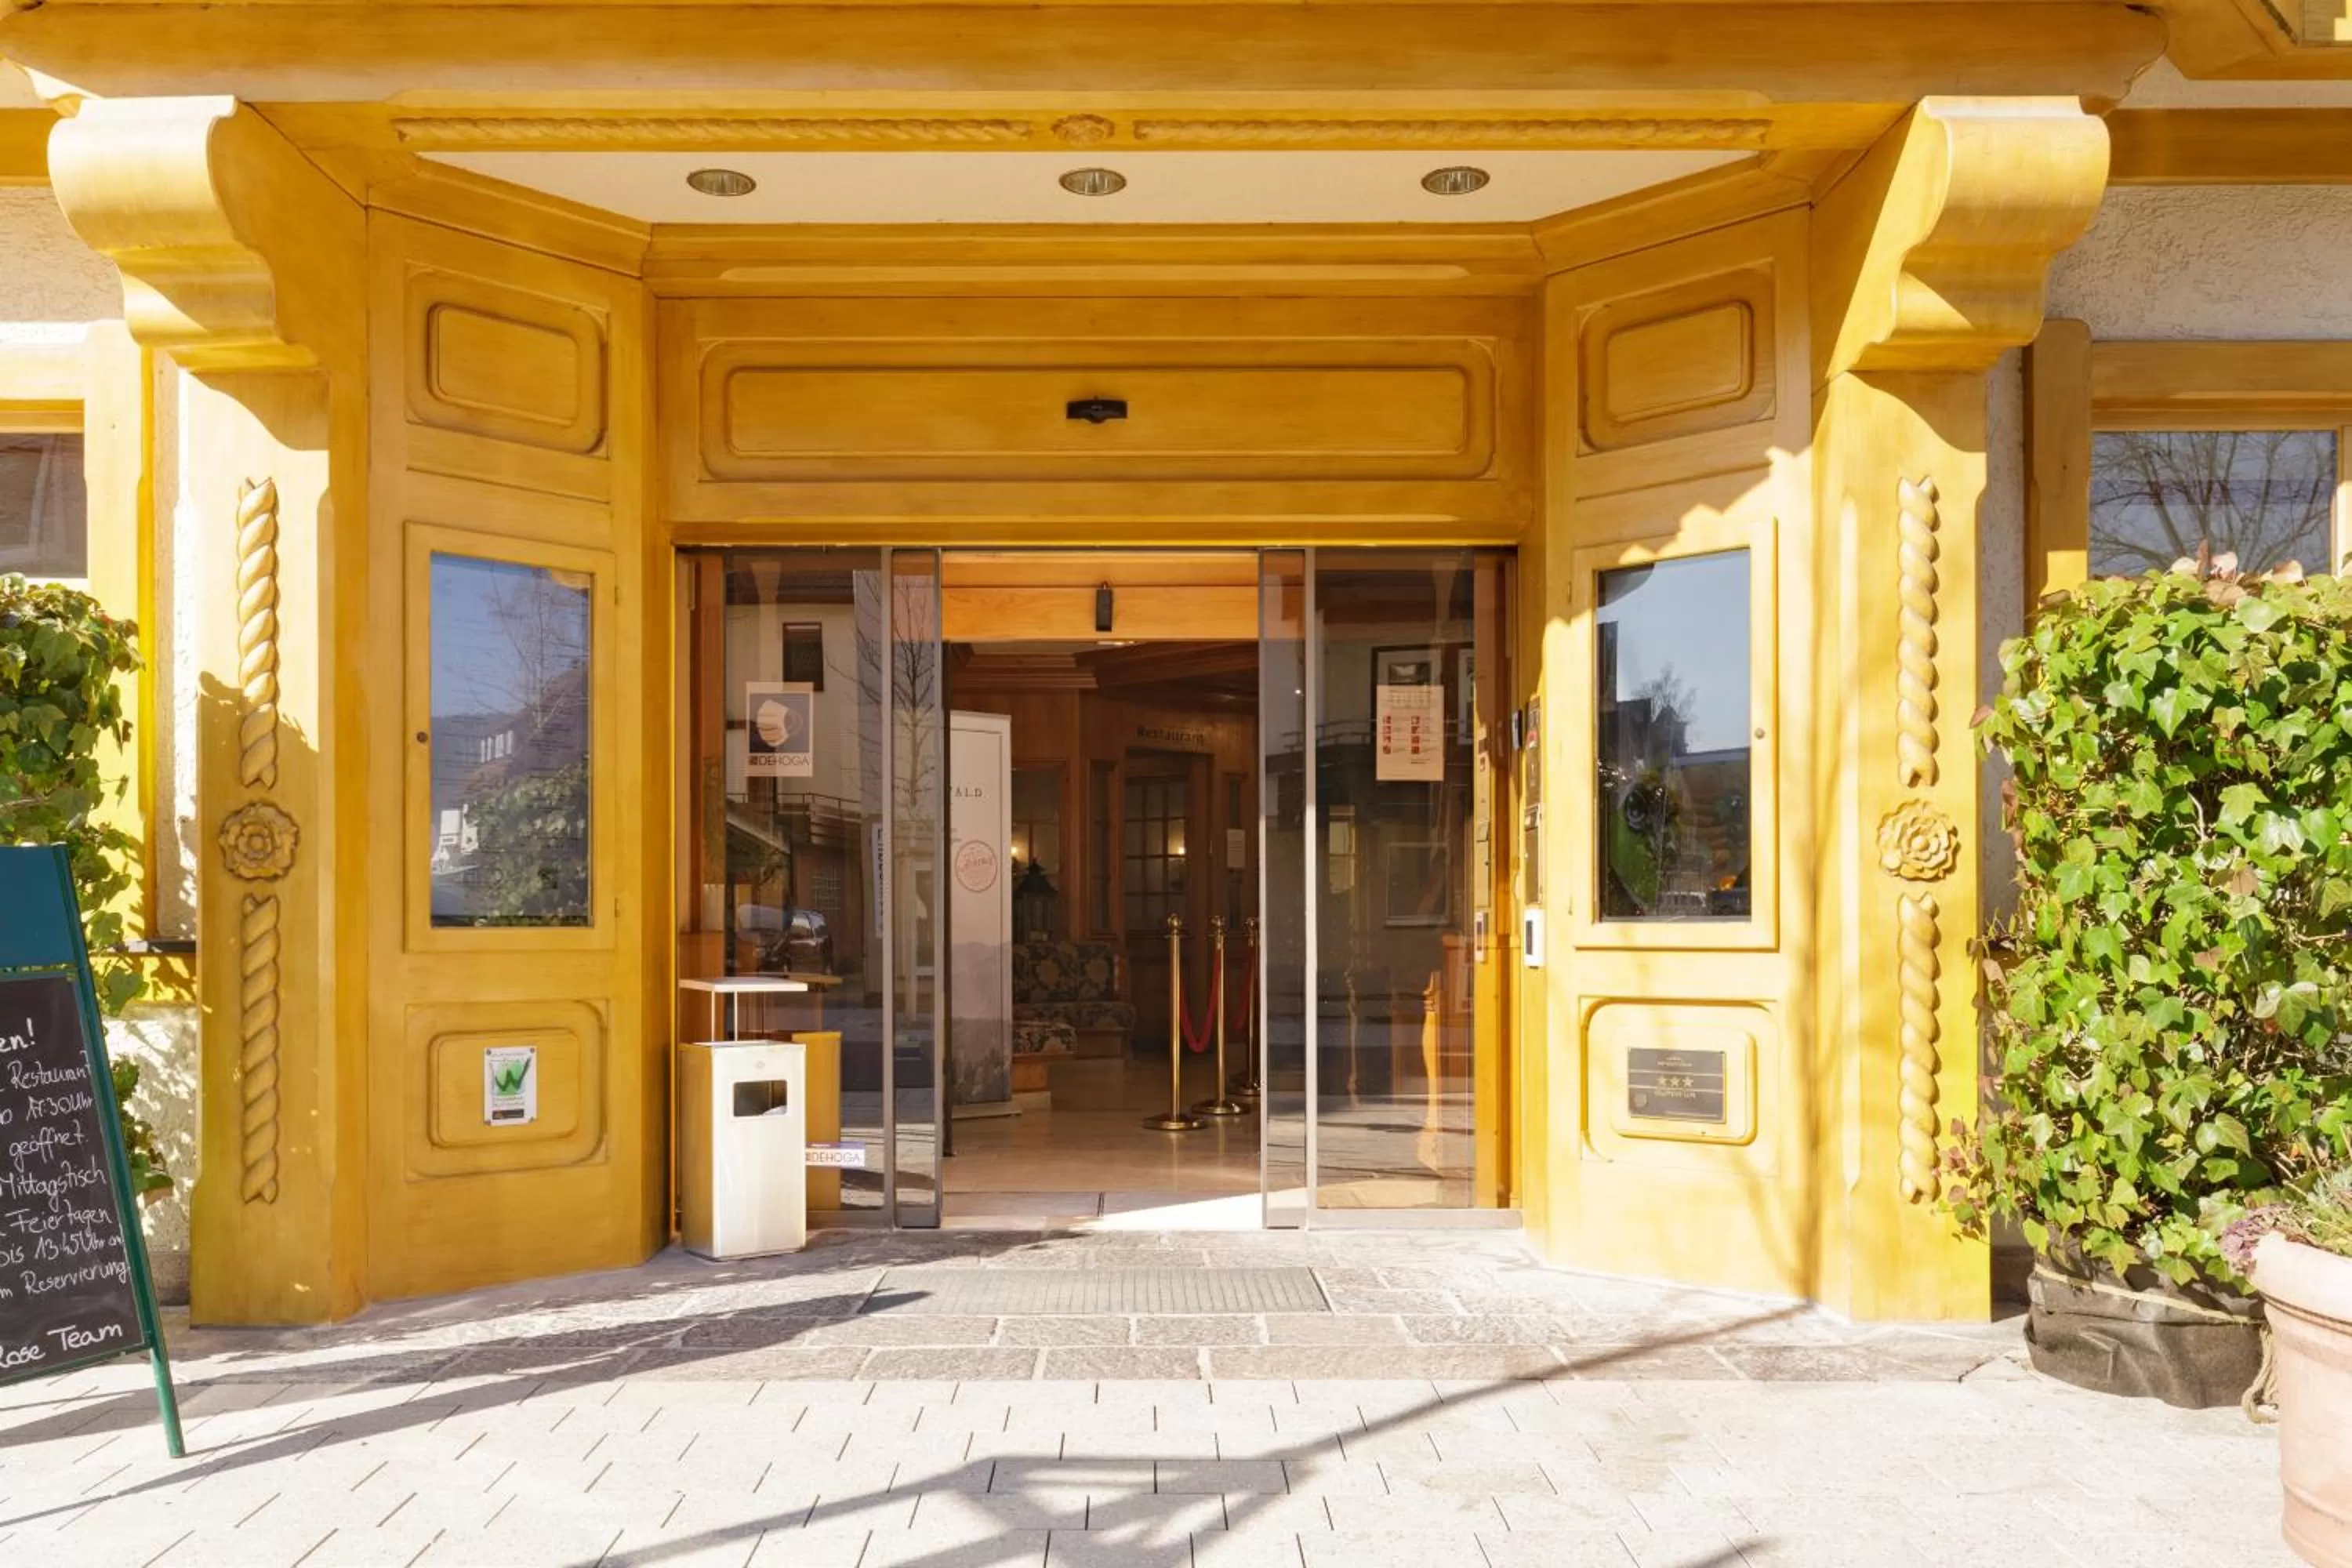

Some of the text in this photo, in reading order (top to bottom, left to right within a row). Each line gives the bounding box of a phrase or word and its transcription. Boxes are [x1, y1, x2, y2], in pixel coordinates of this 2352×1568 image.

[758, 755, 810, 766] DEHOGA
[950, 786, 983, 797] ALD
[811, 1152, 860, 1163] DEHOGA
[5, 1199, 113, 1237] Feiertagen
[46, 1324, 123, 1351] Team
